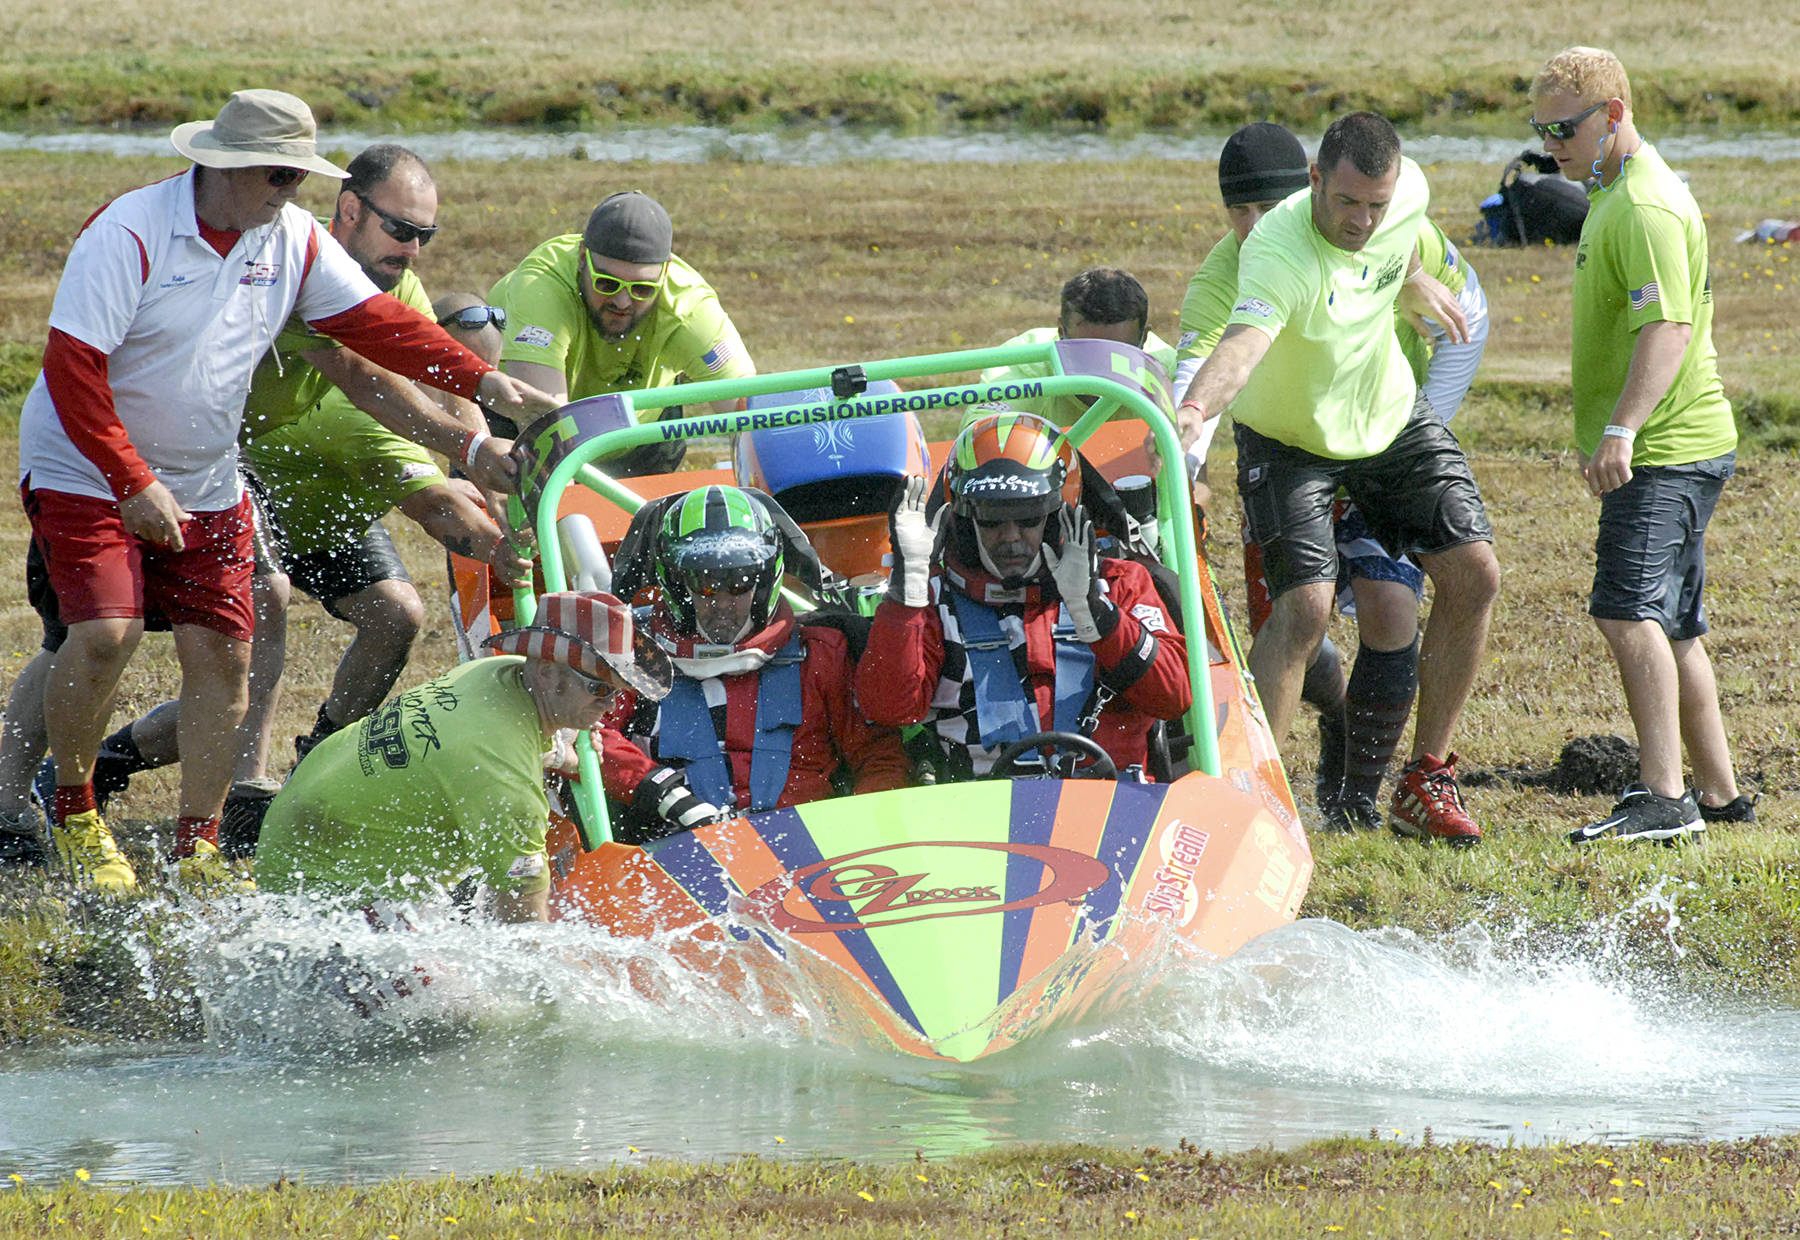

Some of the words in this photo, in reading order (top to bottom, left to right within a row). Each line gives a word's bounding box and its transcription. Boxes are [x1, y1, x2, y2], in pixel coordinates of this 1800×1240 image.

[660, 382, 1043, 441] WWW.PRECISIONPROPCO.COM
[964, 474, 1004, 489] Central
[1143, 824, 1210, 919] SlipStream
